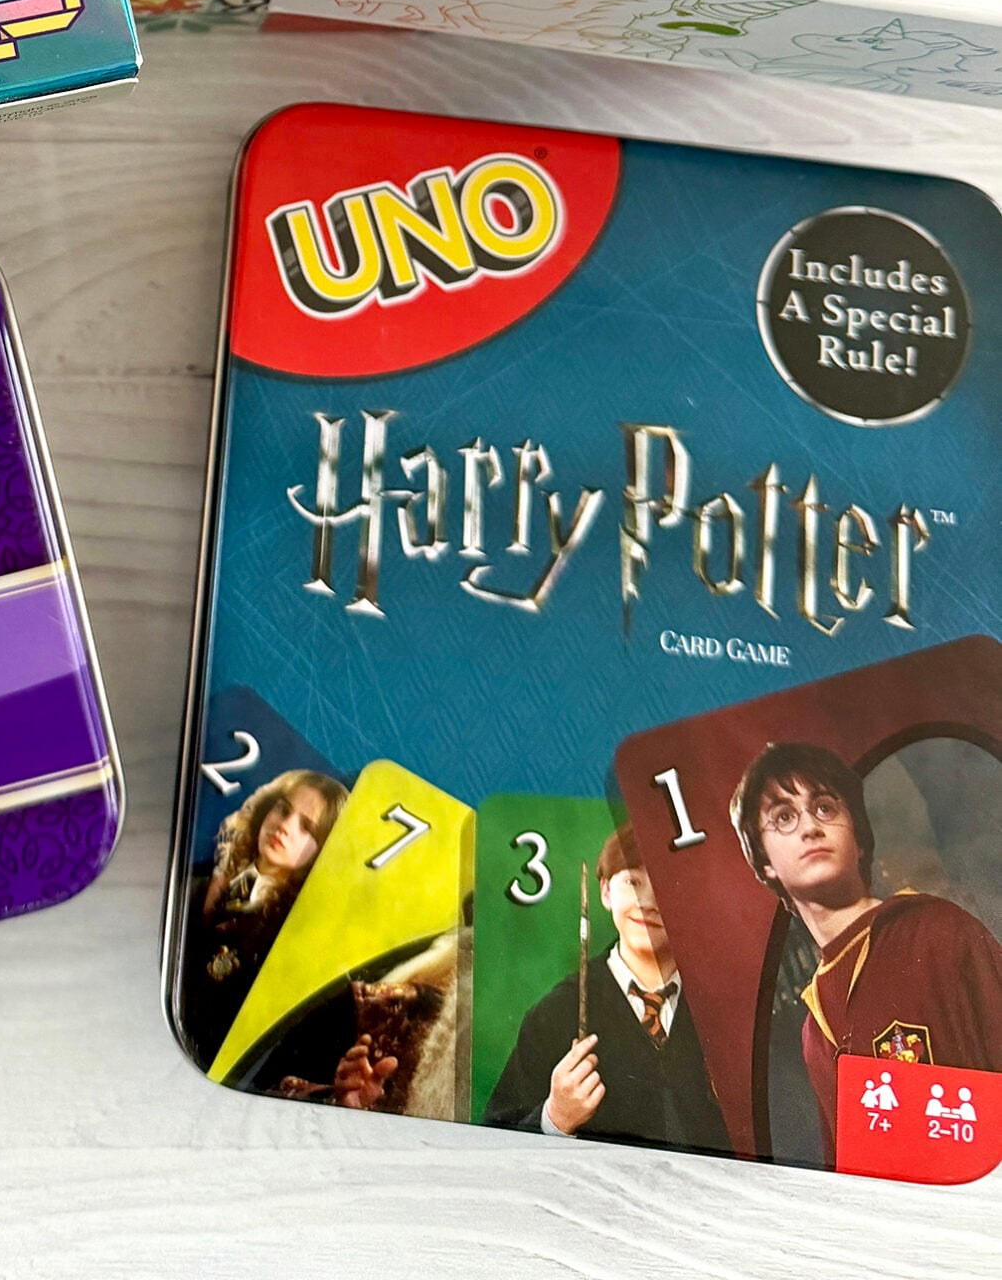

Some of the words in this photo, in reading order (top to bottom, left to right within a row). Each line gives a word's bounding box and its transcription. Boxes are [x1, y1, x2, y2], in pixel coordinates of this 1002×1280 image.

[788, 248, 949, 297] Includes
[779, 293, 809, 324] A
[821, 294, 957, 340] Special
[816, 334, 918, 376] Rule!
[286, 409, 606, 617] Harry
[659, 628, 721, 660] CARD
[726, 636, 791, 668] GAME
[201, 729, 262, 798] 2
[365, 803, 431, 871] 7
[653, 767, 709, 851] 1
[509, 831, 552, 906] 3
[867, 1112, 892, 1132] 7+
